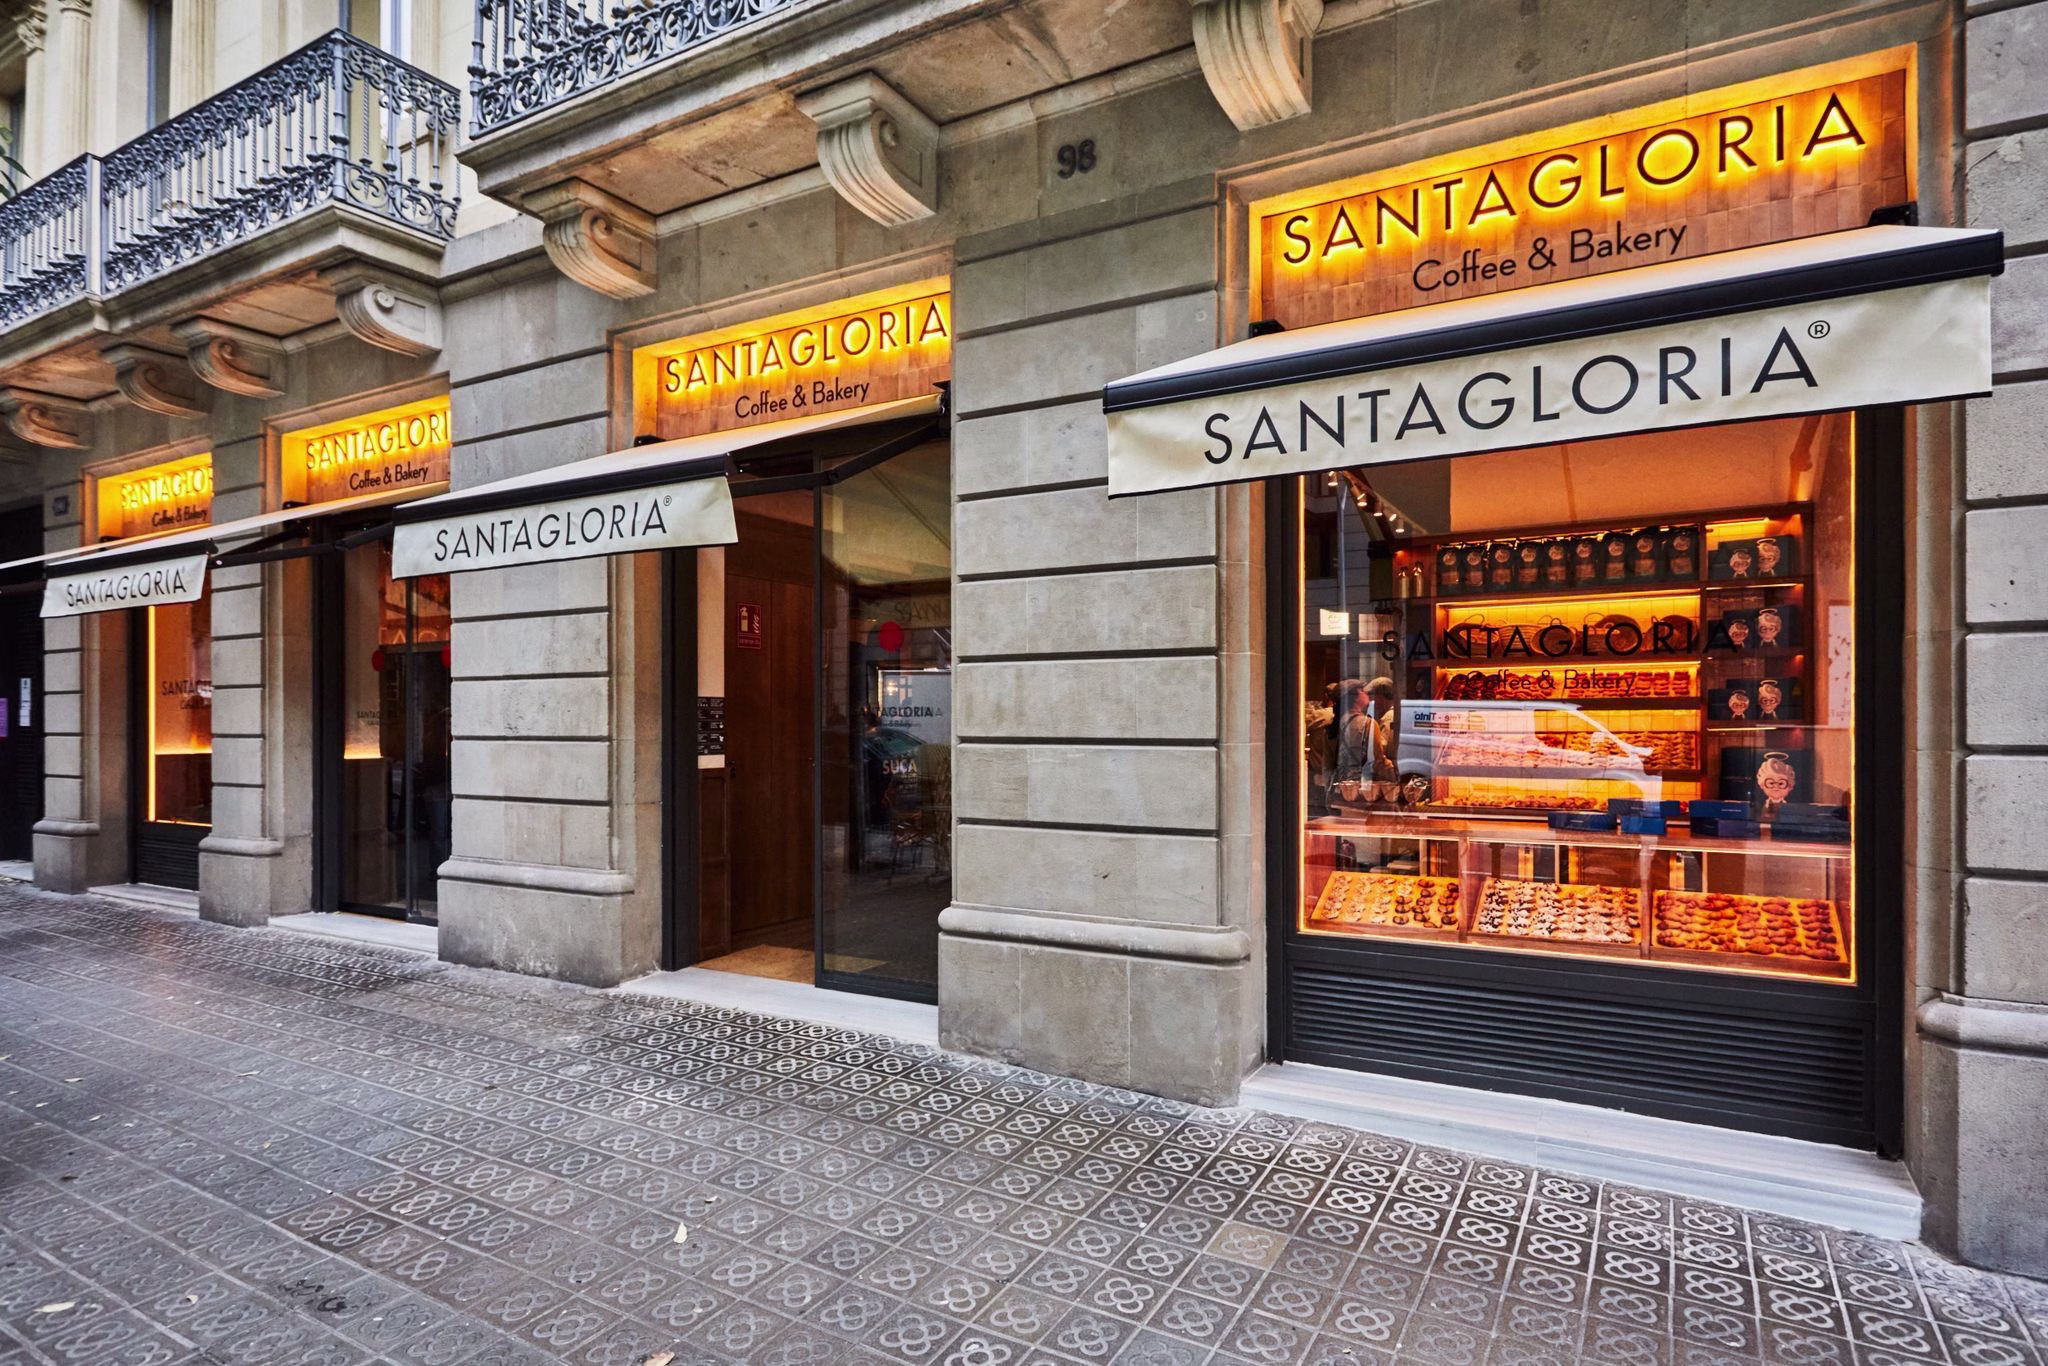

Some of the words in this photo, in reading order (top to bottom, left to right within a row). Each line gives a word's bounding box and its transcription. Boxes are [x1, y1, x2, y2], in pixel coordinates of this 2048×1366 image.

[1057, 138, 1097, 179] 98
[1281, 92, 1867, 266] SANTAGLORIA
[1411, 246, 1518, 294] Coffee
[1526, 236, 1558, 270] &
[1568, 220, 1688, 268] Bakery
[664, 299, 948, 394] SANTAGLORIA
[734, 389, 788, 419] Coffee
[791, 385, 807, 406] &
[811, 377, 870, 405] Bakery
[349, 469, 382, 491] Coffee
[383, 466, 393, 484] &
[394, 460, 429, 482] Bakery
[1381, 620, 1738, 663] SANTAGLORIA
[1467, 668, 1532, 691] Coffee
[1536, 669, 1557, 690] &
[1563, 667, 1637, 697] Bakery
